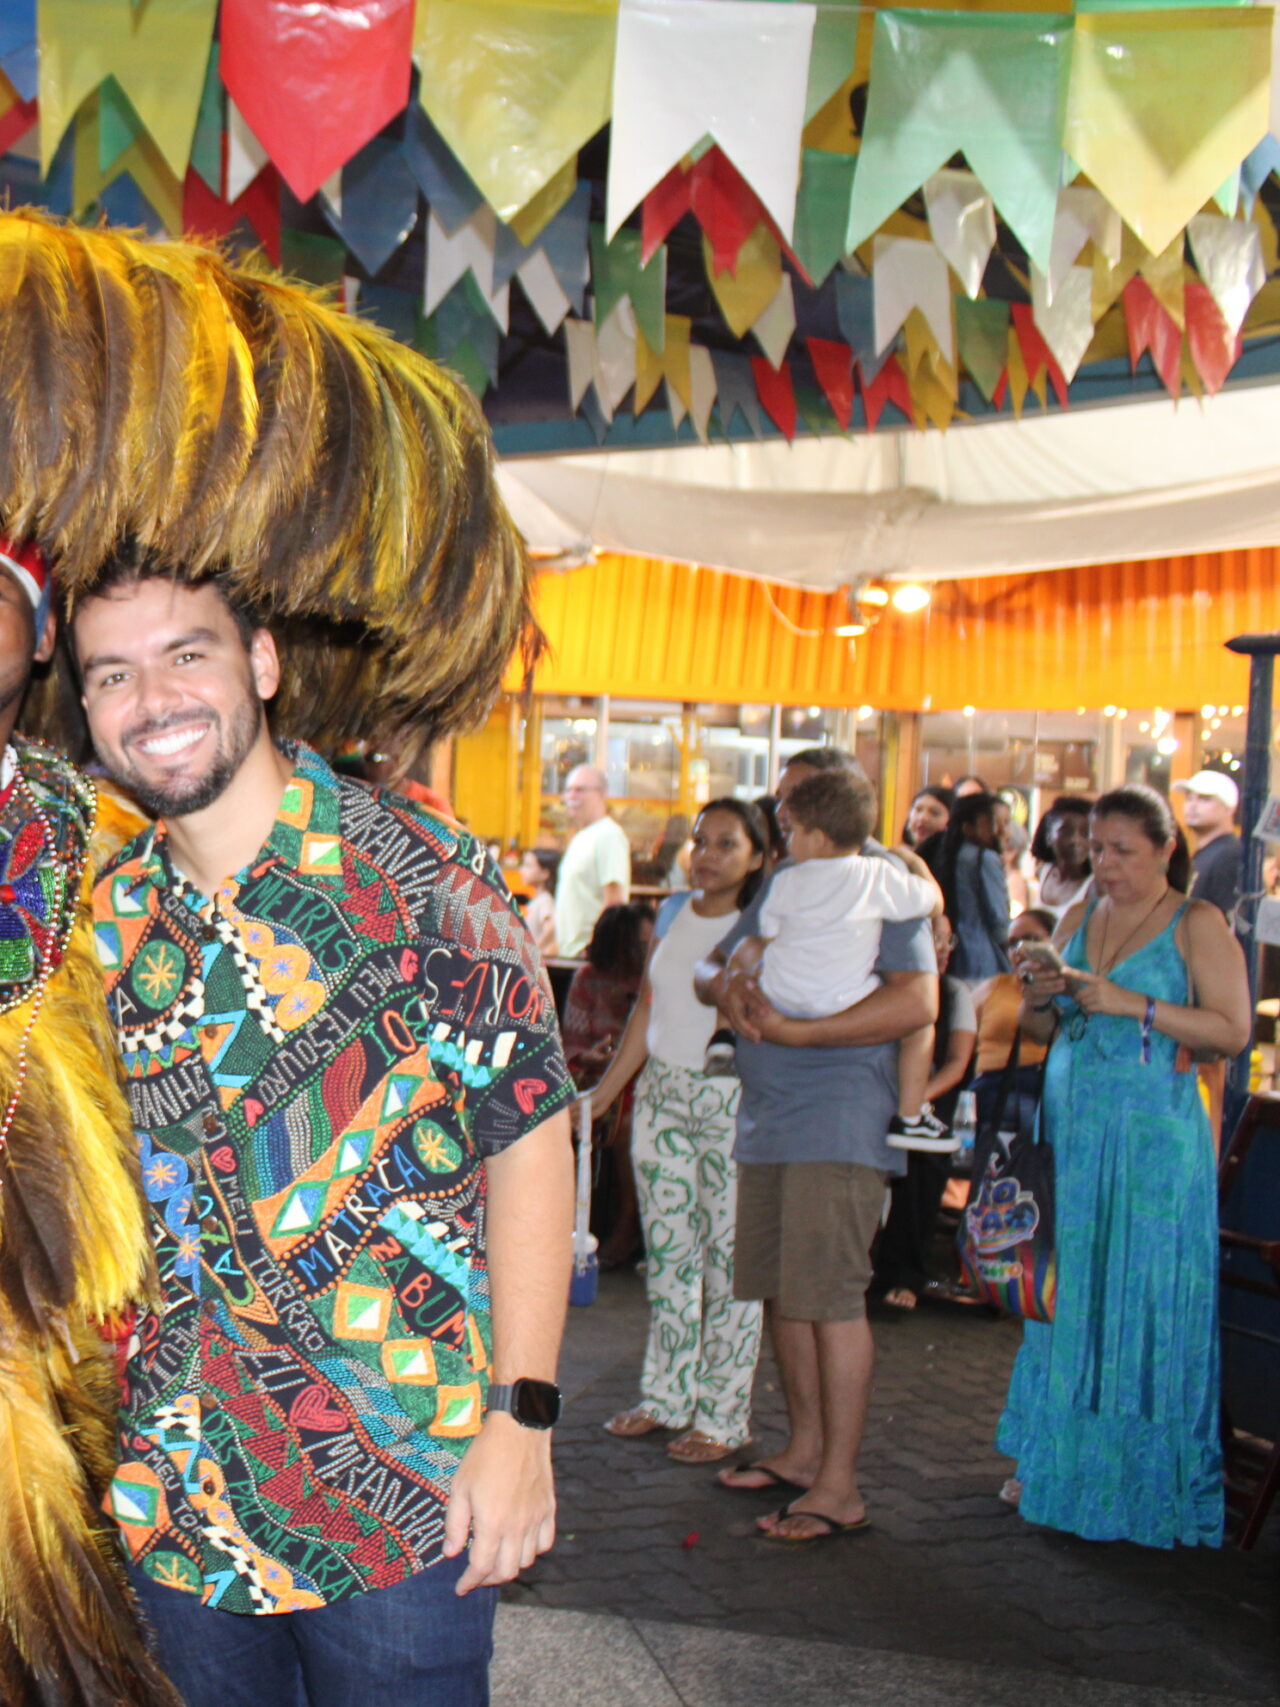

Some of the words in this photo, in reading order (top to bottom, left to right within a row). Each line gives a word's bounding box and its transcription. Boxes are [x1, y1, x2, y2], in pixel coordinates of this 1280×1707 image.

[348, 954, 404, 1008] MEU
[257, 1006, 361, 1106] TESOURO
[219, 1175, 253, 1235] MEU
[249, 1249, 325, 1352] TORRÃO
[297, 1144, 426, 1286] MATRACA
[370, 1236, 466, 1345] ZABUM
[143, 1449, 181, 1491] MEU
[173, 1497, 205, 1543] TOR
